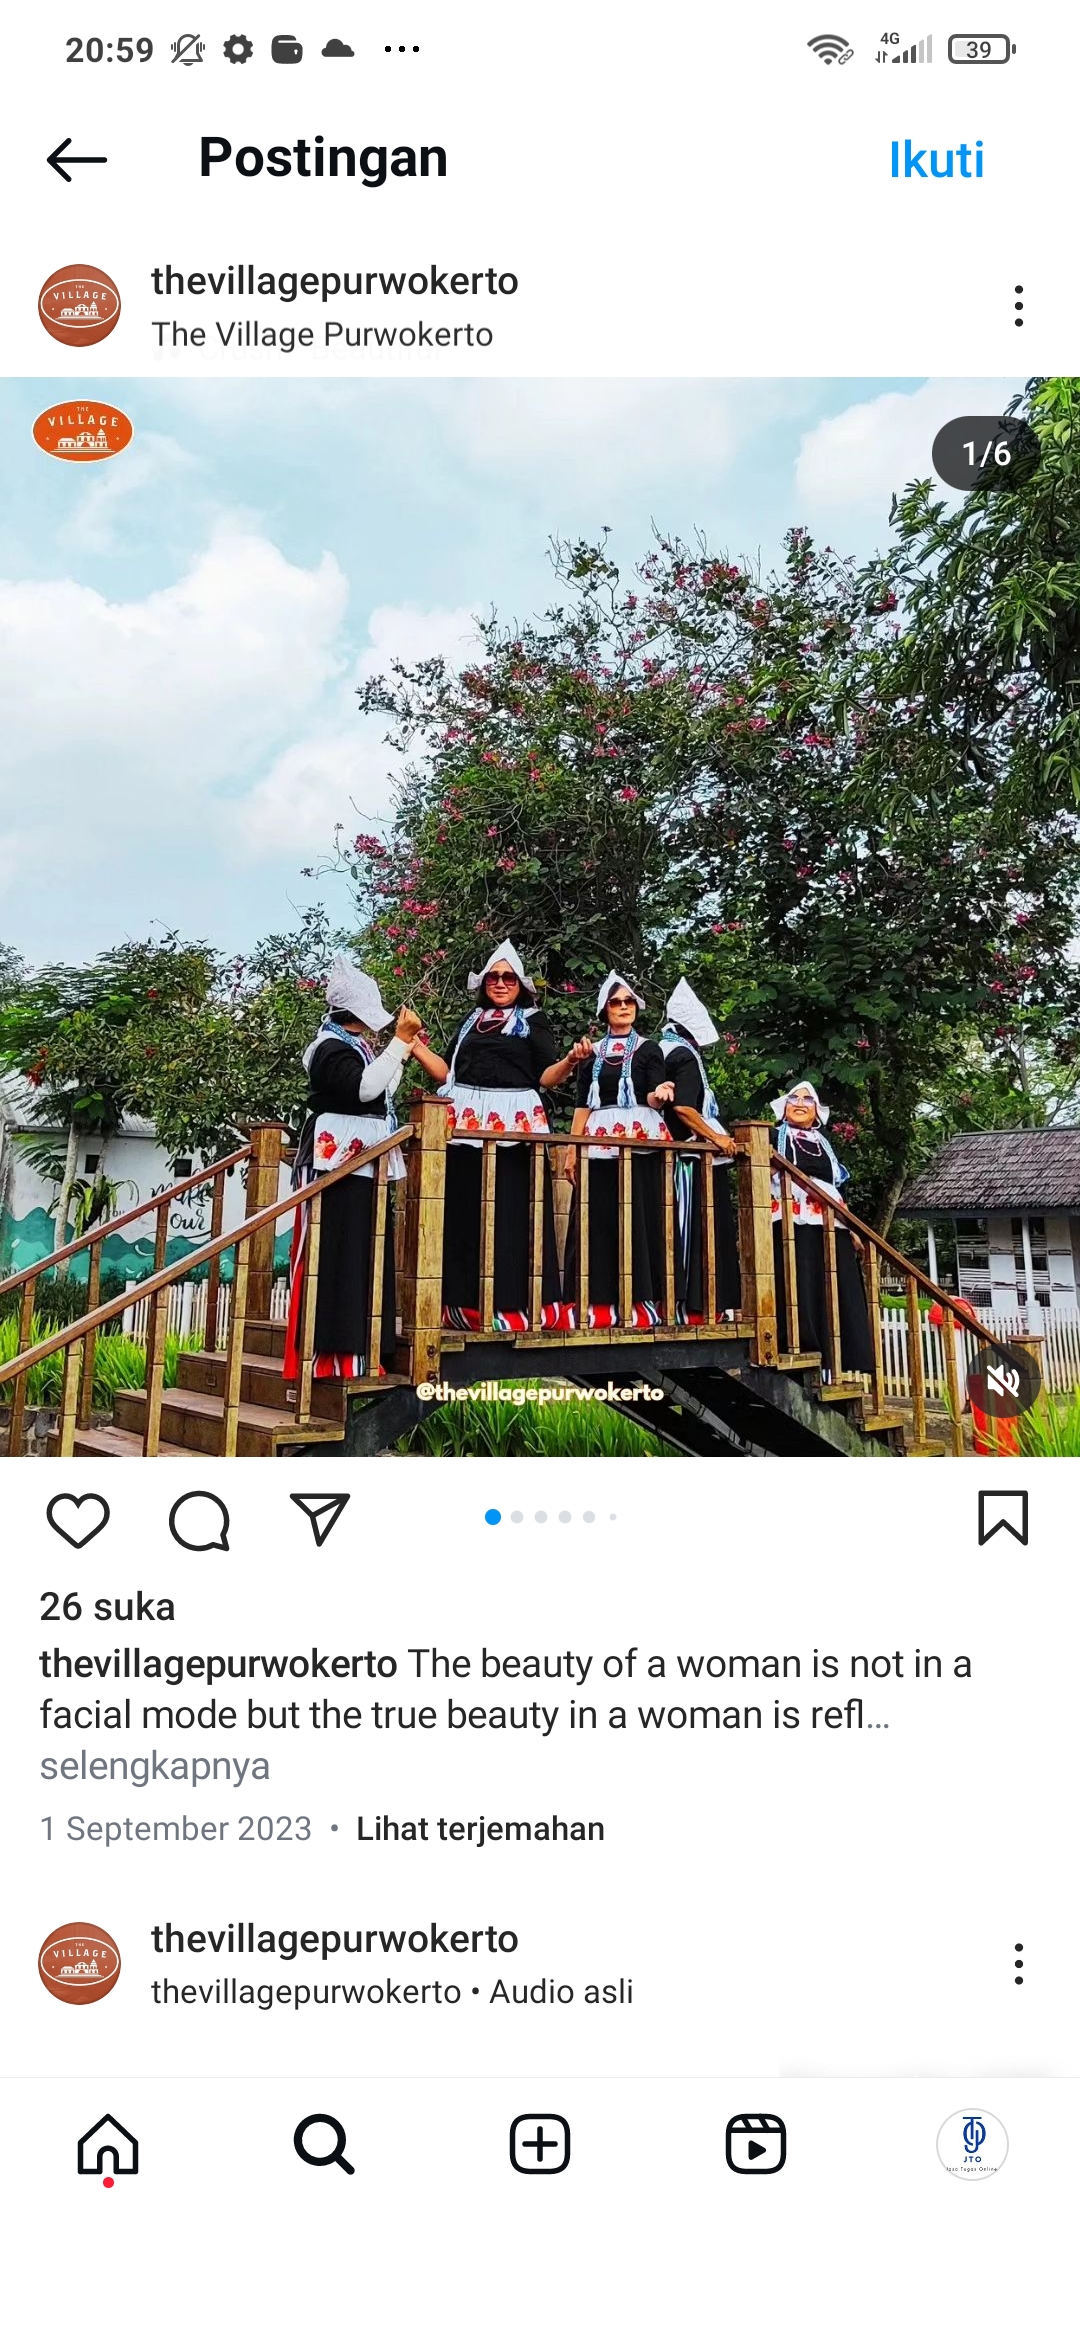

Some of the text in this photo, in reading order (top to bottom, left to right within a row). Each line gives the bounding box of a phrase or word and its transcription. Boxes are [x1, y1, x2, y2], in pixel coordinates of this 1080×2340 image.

[66, 38, 153, 62] 20:59
[880, 32, 900, 45] 4G
[966, 41, 992, 59] 39
[201, 135, 446, 187] Postingan
[891, 138, 984, 179] Ikuti
[53, 291, 107, 300] VILLAGE
[151, 265, 518, 302] thevillagepurwokerto
[152, 321, 205, 346] The
[216, 321, 313, 353] Village
[326, 321, 492, 346] Purwokerto
[963, 441, 1011, 468] 1/6
[41, 1591, 174, 1620] 26 suka
[39, 1647, 971, 1685] thevillagepurwokerto The beauty of a woman is not in a
[40, 1698, 130, 1728] facial
[144, 1699, 236, 1728] mode
[249, 1699, 299, 1728] but
[309, 1699, 361, 1728] the
[371, 1702, 436, 1728] true
[449, 1699, 559, 1736] beauty
[571, 1700, 596, 1728] in
[609, 1707, 626, 1728] a
[638, 1707, 761, 1728] woman
[775, 1700, 799, 1728] is
[41, 1750, 269, 1787] selengkapnya
[42, 1815, 603, 1847] 1 September 2023 Lihat terjemahan
[53, 1949, 107, 1958] VILLAGE
[151, 1923, 518, 1960] thevillagepurwokerto
[151, 1978, 632, 2010] thevillagepurwokerto Audio asli
